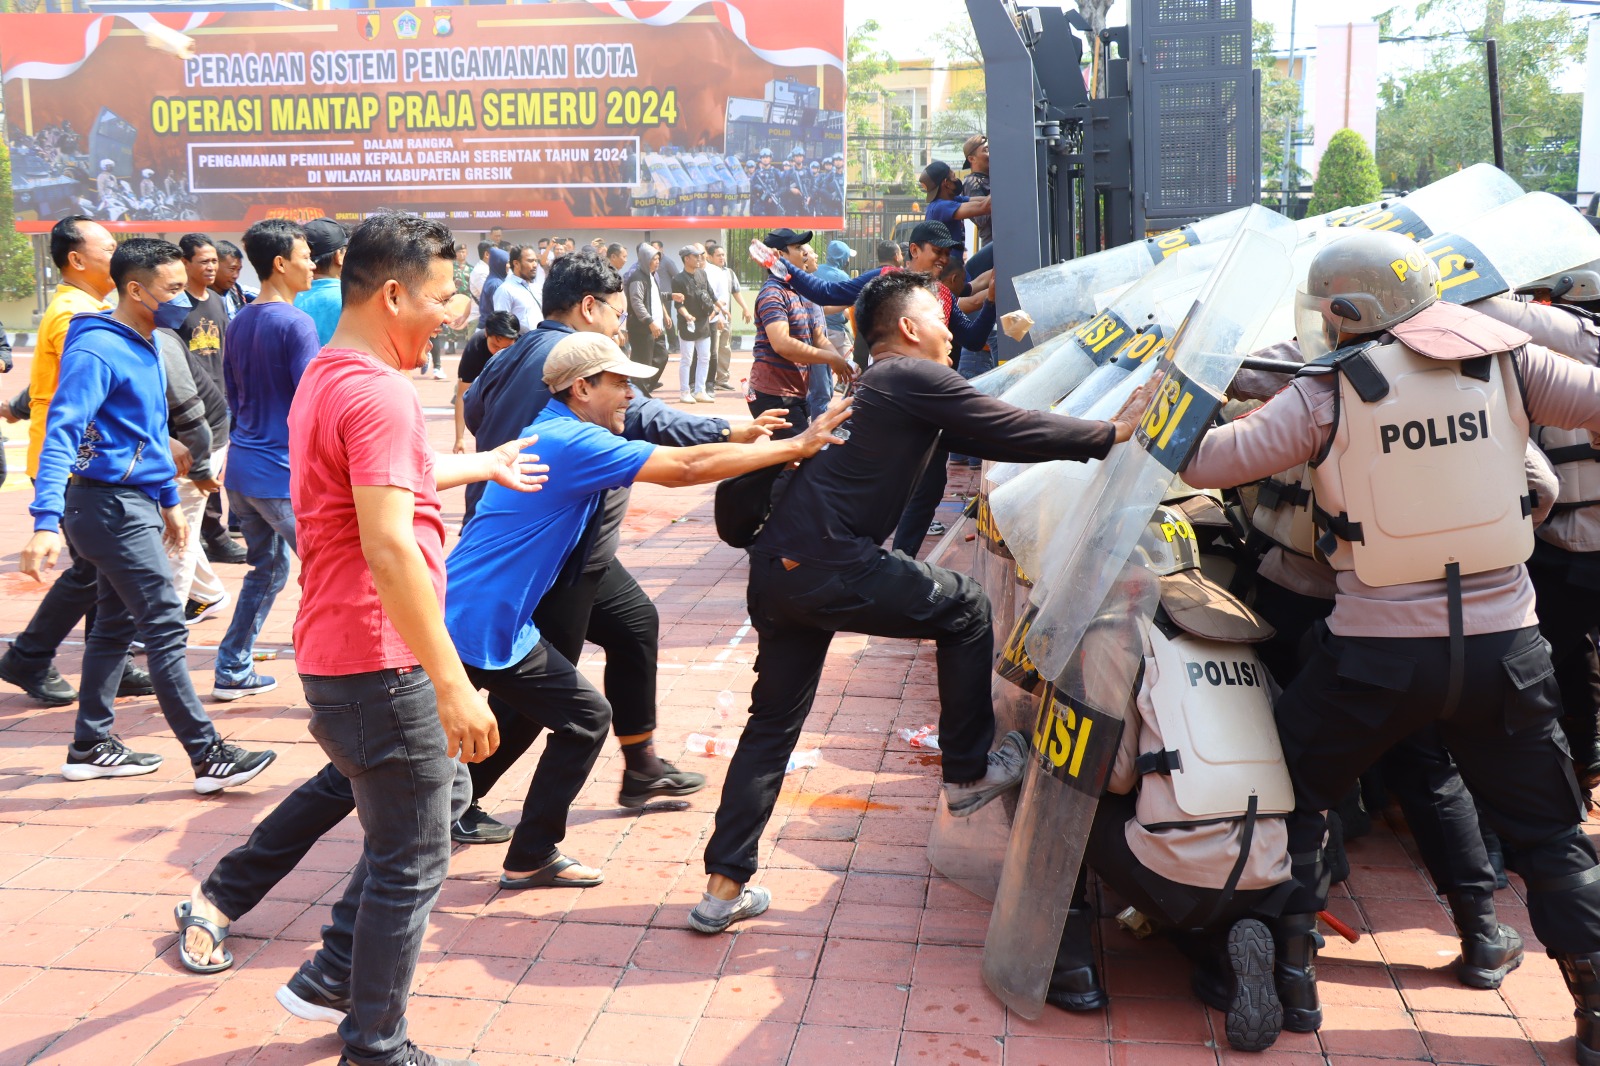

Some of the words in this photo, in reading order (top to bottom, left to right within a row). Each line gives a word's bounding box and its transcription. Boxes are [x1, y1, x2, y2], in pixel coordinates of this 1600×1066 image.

[185, 52, 305, 87] PERAGAAN
[311, 50, 397, 85] SISTEM
[404, 46, 568, 82] PENGAMANAN
[575, 44, 638, 79] KOTA
[152, 98, 262, 133] OPERASI
[271, 96, 379, 131] MANTAP
[388, 93, 475, 129] PRAJA
[483, 91, 597, 127] SEMERU
[607, 90, 677, 125] 2024
[363, 139, 404, 150] DALAM
[407, 137, 454, 149] RANGKA
[198, 154, 287, 168] PENGAMANAN
[290, 152, 361, 167] PEMILIHAN
[365, 151, 414, 165] KEPALA
[417, 150, 470, 164] DAERAH
[474, 149, 541, 163] SERENTAK
[544, 148, 590, 162] TAHUN
[594, 148, 628, 161] 2024
[307, 170, 321, 183] DI
[325, 169, 381, 183] WILAYAH
[385, 168, 460, 182] KABUPATEN
[465, 167, 513, 181] GRESIK
[1380, 410, 1488, 454] POLISI
[1186, 660, 1261, 688] POLISI
